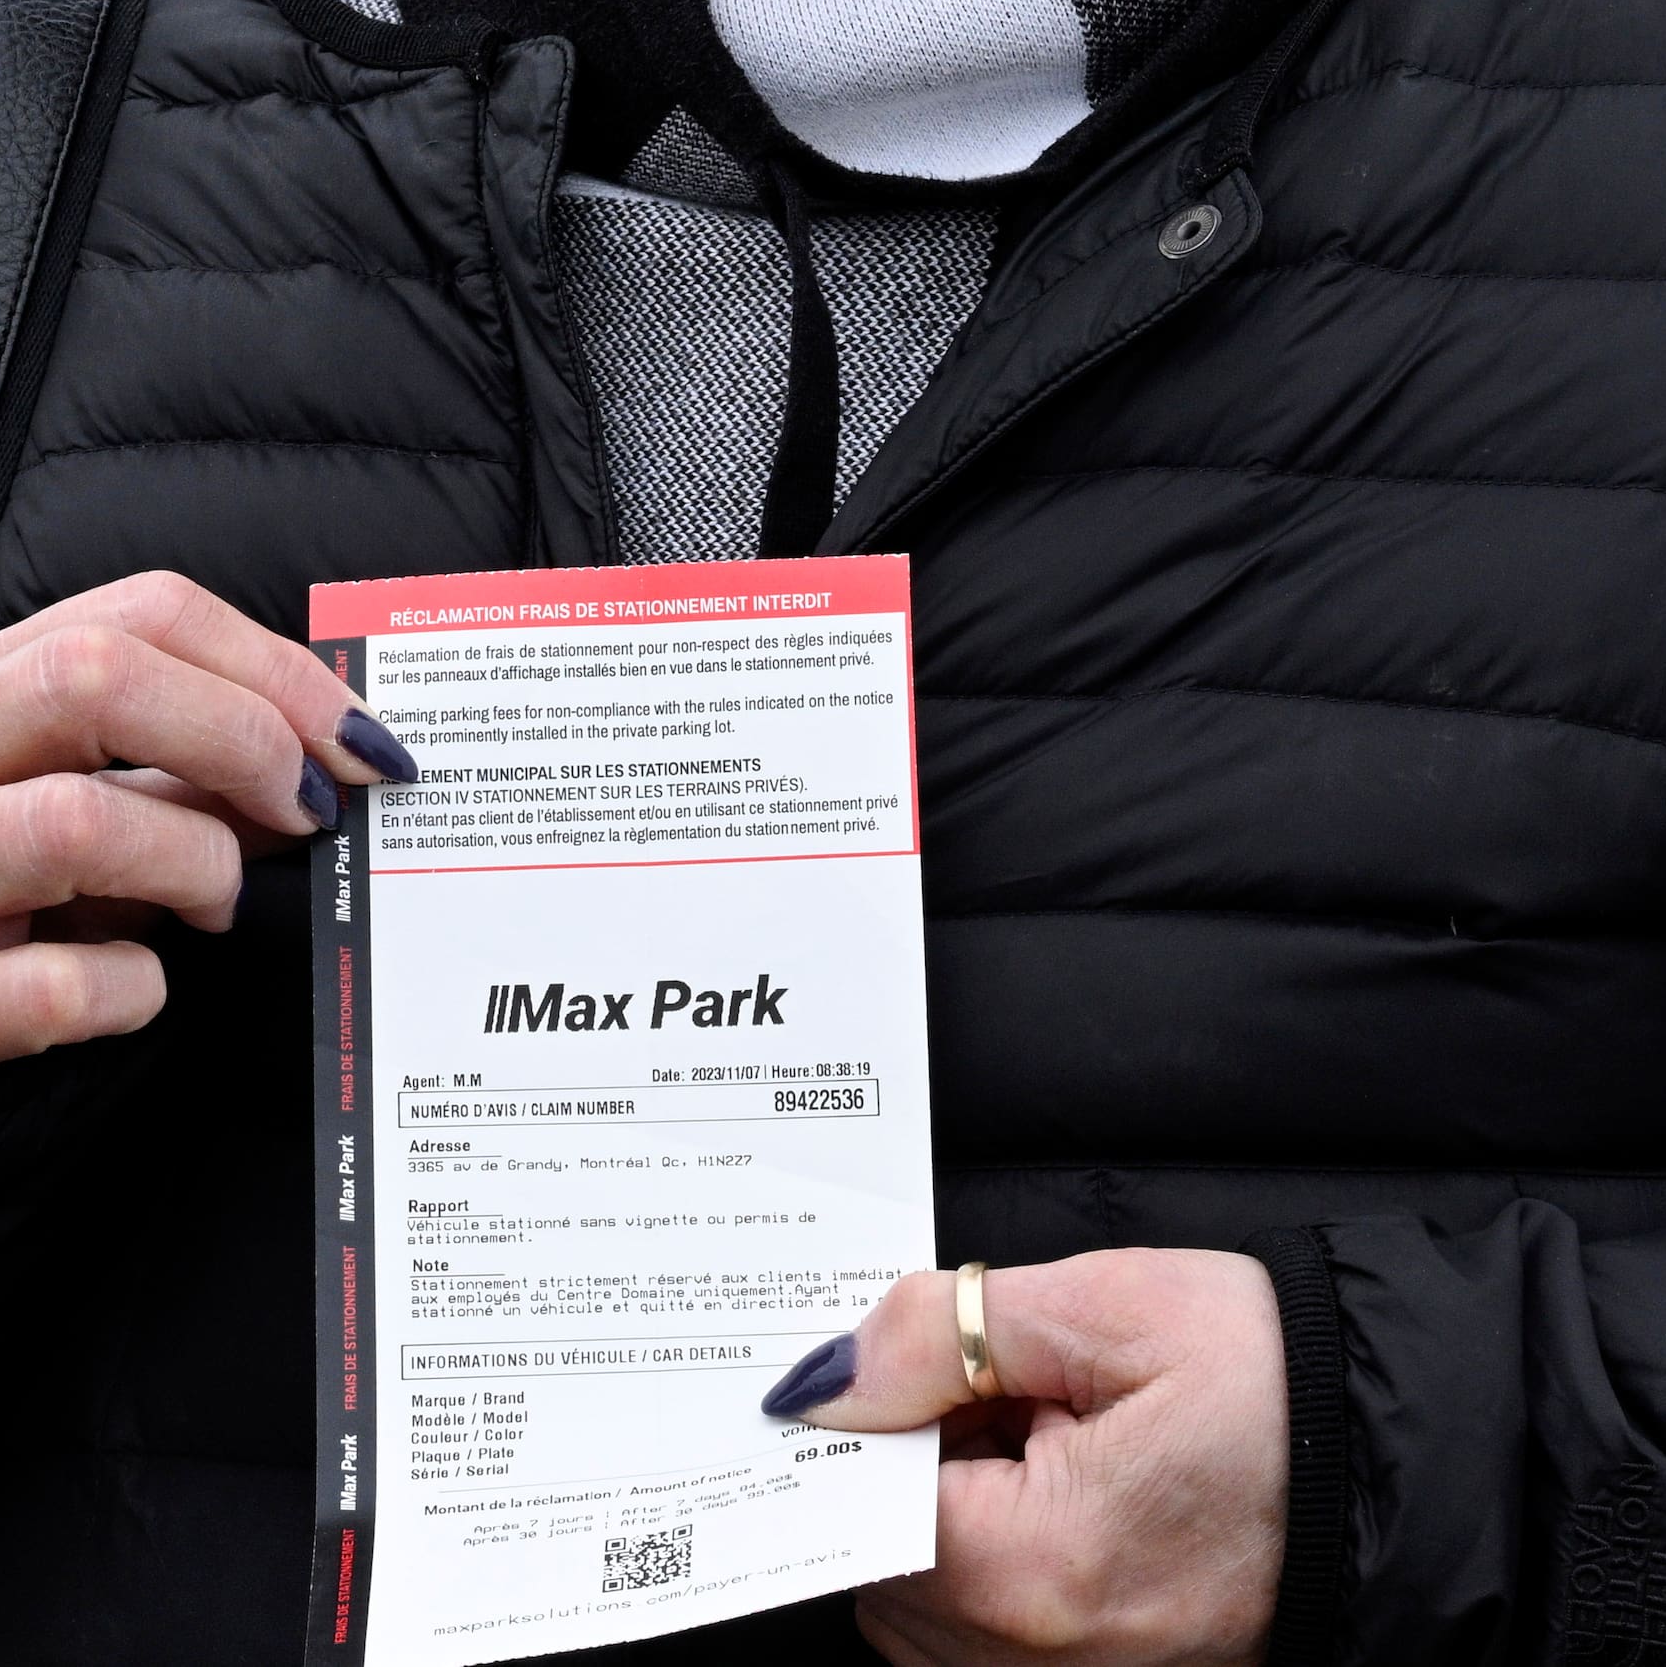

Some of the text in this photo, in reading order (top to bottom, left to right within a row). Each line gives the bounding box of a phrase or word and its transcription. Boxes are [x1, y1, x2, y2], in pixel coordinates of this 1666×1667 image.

[390, 592, 832, 627] RÉCLAMATION FRAIS DE STATIONNEMENT INTERDIT
[379, 630, 892, 664] Réclamation de frais de stationnement pour non-respect des règles indiquées
[379, 652, 874, 685] sur les panneaux d'affichage installés bien en vue dans le stationnement privé.
[379, 691, 893, 725] Claiming parking fees for non-compliance with the rules indicated on the notice
[397, 720, 735, 746] ards prominently installed in the private parking lot.
[477, 766, 557, 782] MUNICIPAL
[561, 765, 591, 779] SUR
[596, 764, 624, 777] LES
[628, 758, 761, 777] STATIONNEMENTS
[381, 776, 807, 809] (SECTION IV STATIONNEMENT SUR LES TERRAINS PRIVÉS).
[382, 795, 898, 829] En n'étant pas client de l'établissement et/ou en utilisant ce stationnement privé
[382, 817, 879, 849] sans autorisation, vous enfreignez la règlementation du stationnement privé.
[333, 834, 351, 874] Park
[650, 974, 788, 1029] Park
[403, 1074, 481, 1090] Agent: M.M
[653, 1069, 684, 1082] Date:
[692, 1066, 760, 1080] 2023/11/07
[412, 1101, 634, 1118] NUMÉRO D'AVIS CLAIM NUMBER
[775, 1088, 864, 1111] 89422536
[338, 1134, 355, 1174] Park
[410, 1140, 470, 1152] Adresse
[408, 1155, 752, 1172] 3365 Grandy, Montréal Qc, H1N2Z7
[408, 1200, 470, 1217] Rapport
[407, 1214, 788, 1231] Véhicule stationné vignette permis
[408, 1232, 532, 1244] stationnement.
[413, 1259, 448, 1272] Note
[411, 1270, 821, 1291] Stationnement strictement réservé clients
[448, 1286, 684, 1306] employés Centre Domaine
[411, 1297, 814, 1318] stationné véhicule direction
[412, 1346, 751, 1369] INFORMATIONS DU VÉHICULE CAR DETAILS
[412, 1391, 524, 1409] Marque Brand
[412, 1411, 527, 1427] Modèle Model
[412, 1429, 523, 1444] Couleur Color
[340, 1434, 357, 1471] Park
[412, 1447, 514, 1464] Plaque Plate
[795, 1441, 862, 1462] 69.00$
[411, 1464, 508, 1480] Série Serial
[1606, 1461, 1656, 1628] NORTH
[1566, 1504, 1614, 1628] FACE
